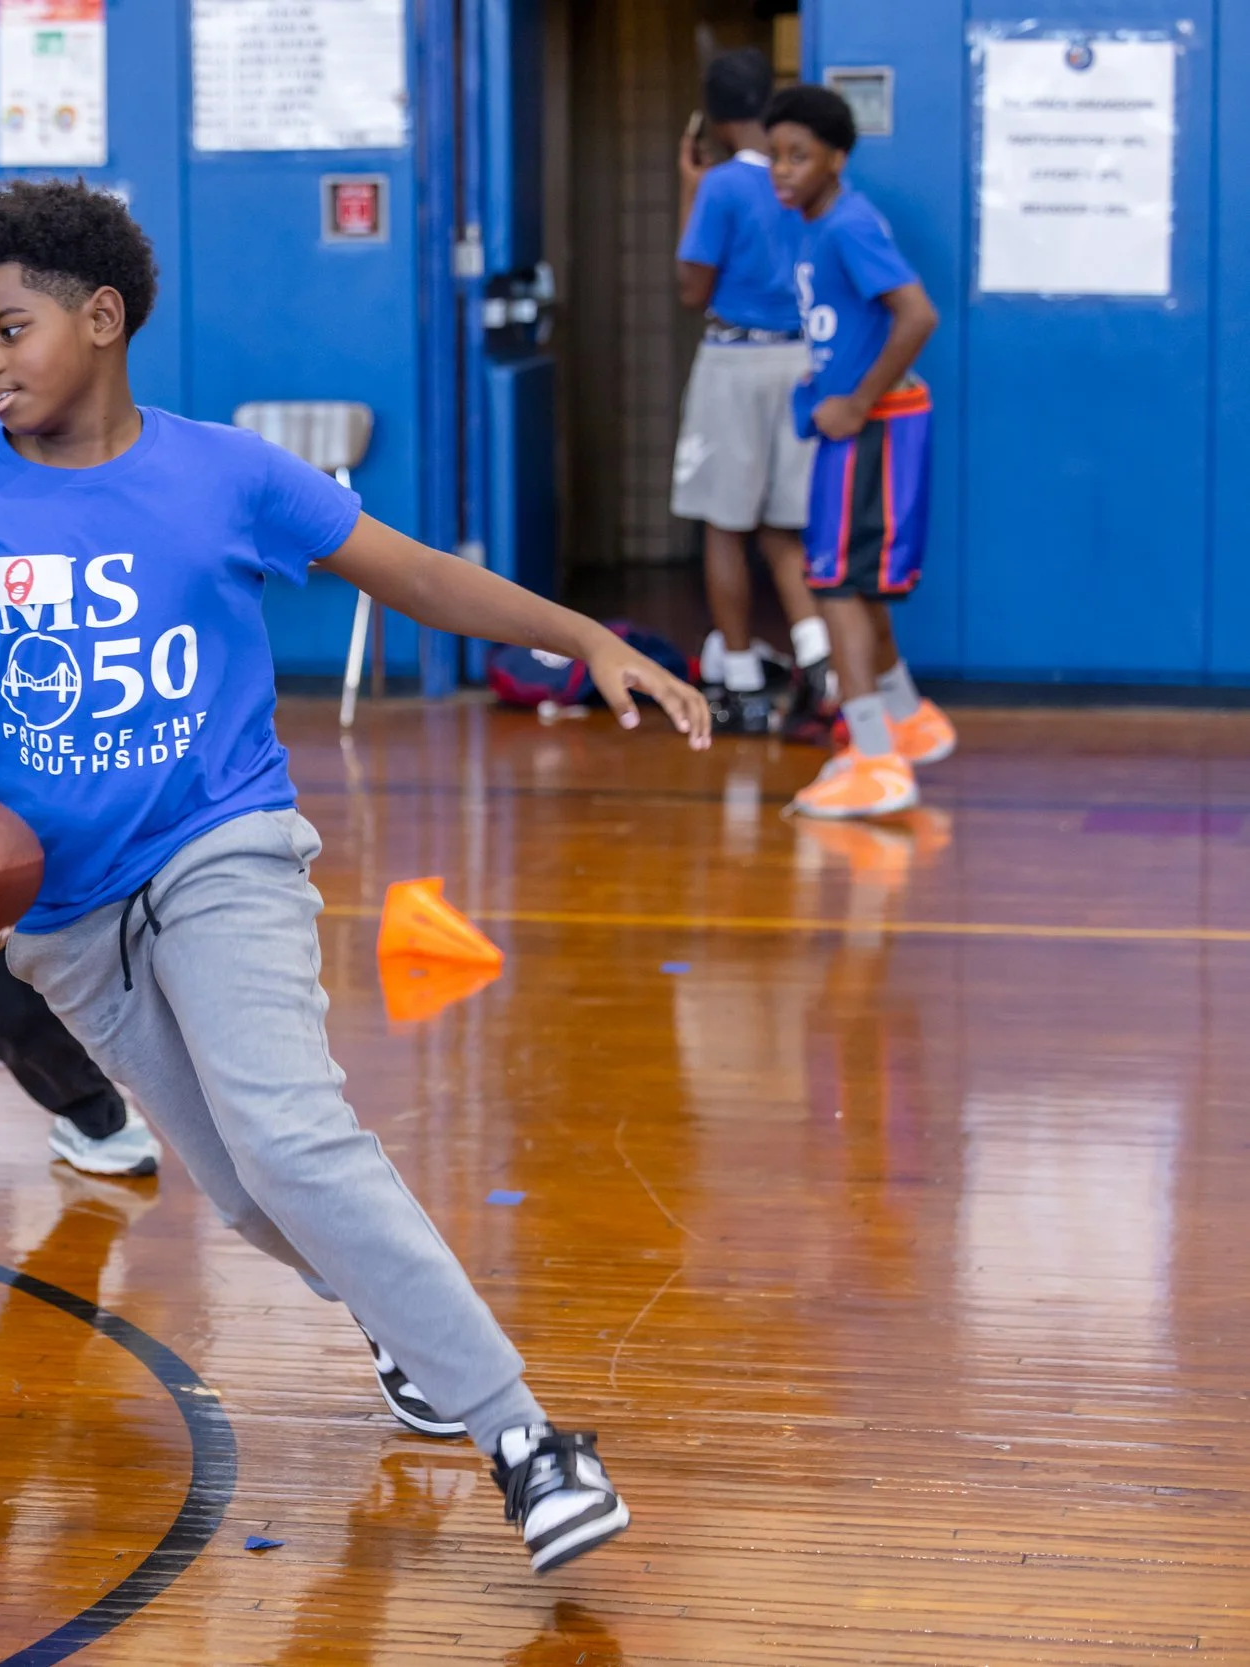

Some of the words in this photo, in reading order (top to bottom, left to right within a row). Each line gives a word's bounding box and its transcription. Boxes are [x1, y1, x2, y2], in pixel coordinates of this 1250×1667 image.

[91, 624, 199, 719] 50
[2, 722, 75, 755] PRIDE
[94, 728, 134, 752] OF
[20, 738, 190, 775] SOUTHSIDE
